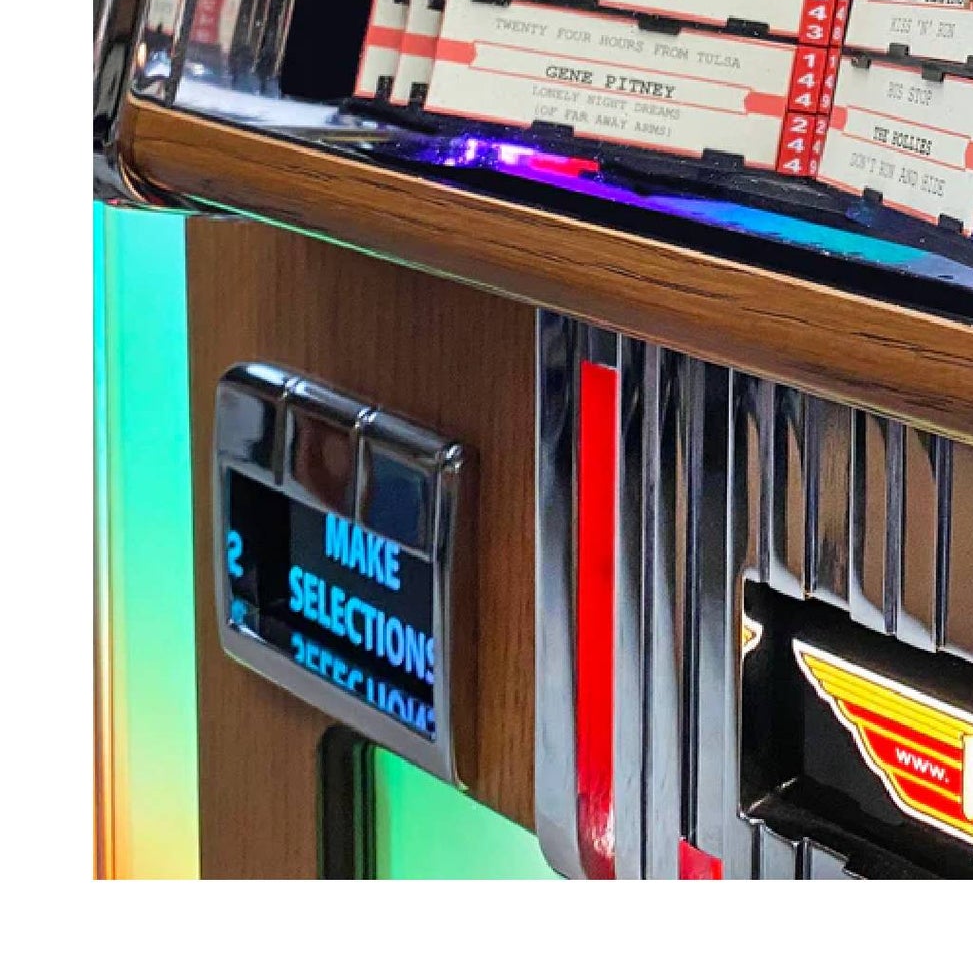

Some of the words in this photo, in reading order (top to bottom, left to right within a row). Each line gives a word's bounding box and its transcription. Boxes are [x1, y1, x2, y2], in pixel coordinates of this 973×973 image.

[495, 17, 548, 37] TWENTY
[556, 25, 592, 42] FOUR
[600, 32, 645, 54] HOURS
[654, 42, 690, 60] FROM
[696, 51, 742, 70] TULSA
[544, 64, 594, 86] GENE
[605, 74, 676, 100] PITNEY
[795, 54, 816, 108] 144
[564, 108, 589, 123] FAR
[586, 93, 627, 111] NIGHT
[634, 101, 682, 121] DREAMS
[782, 118, 808, 174] 244
[325, 511, 401, 591] MAKE
[894, 745, 951, 785] www.
